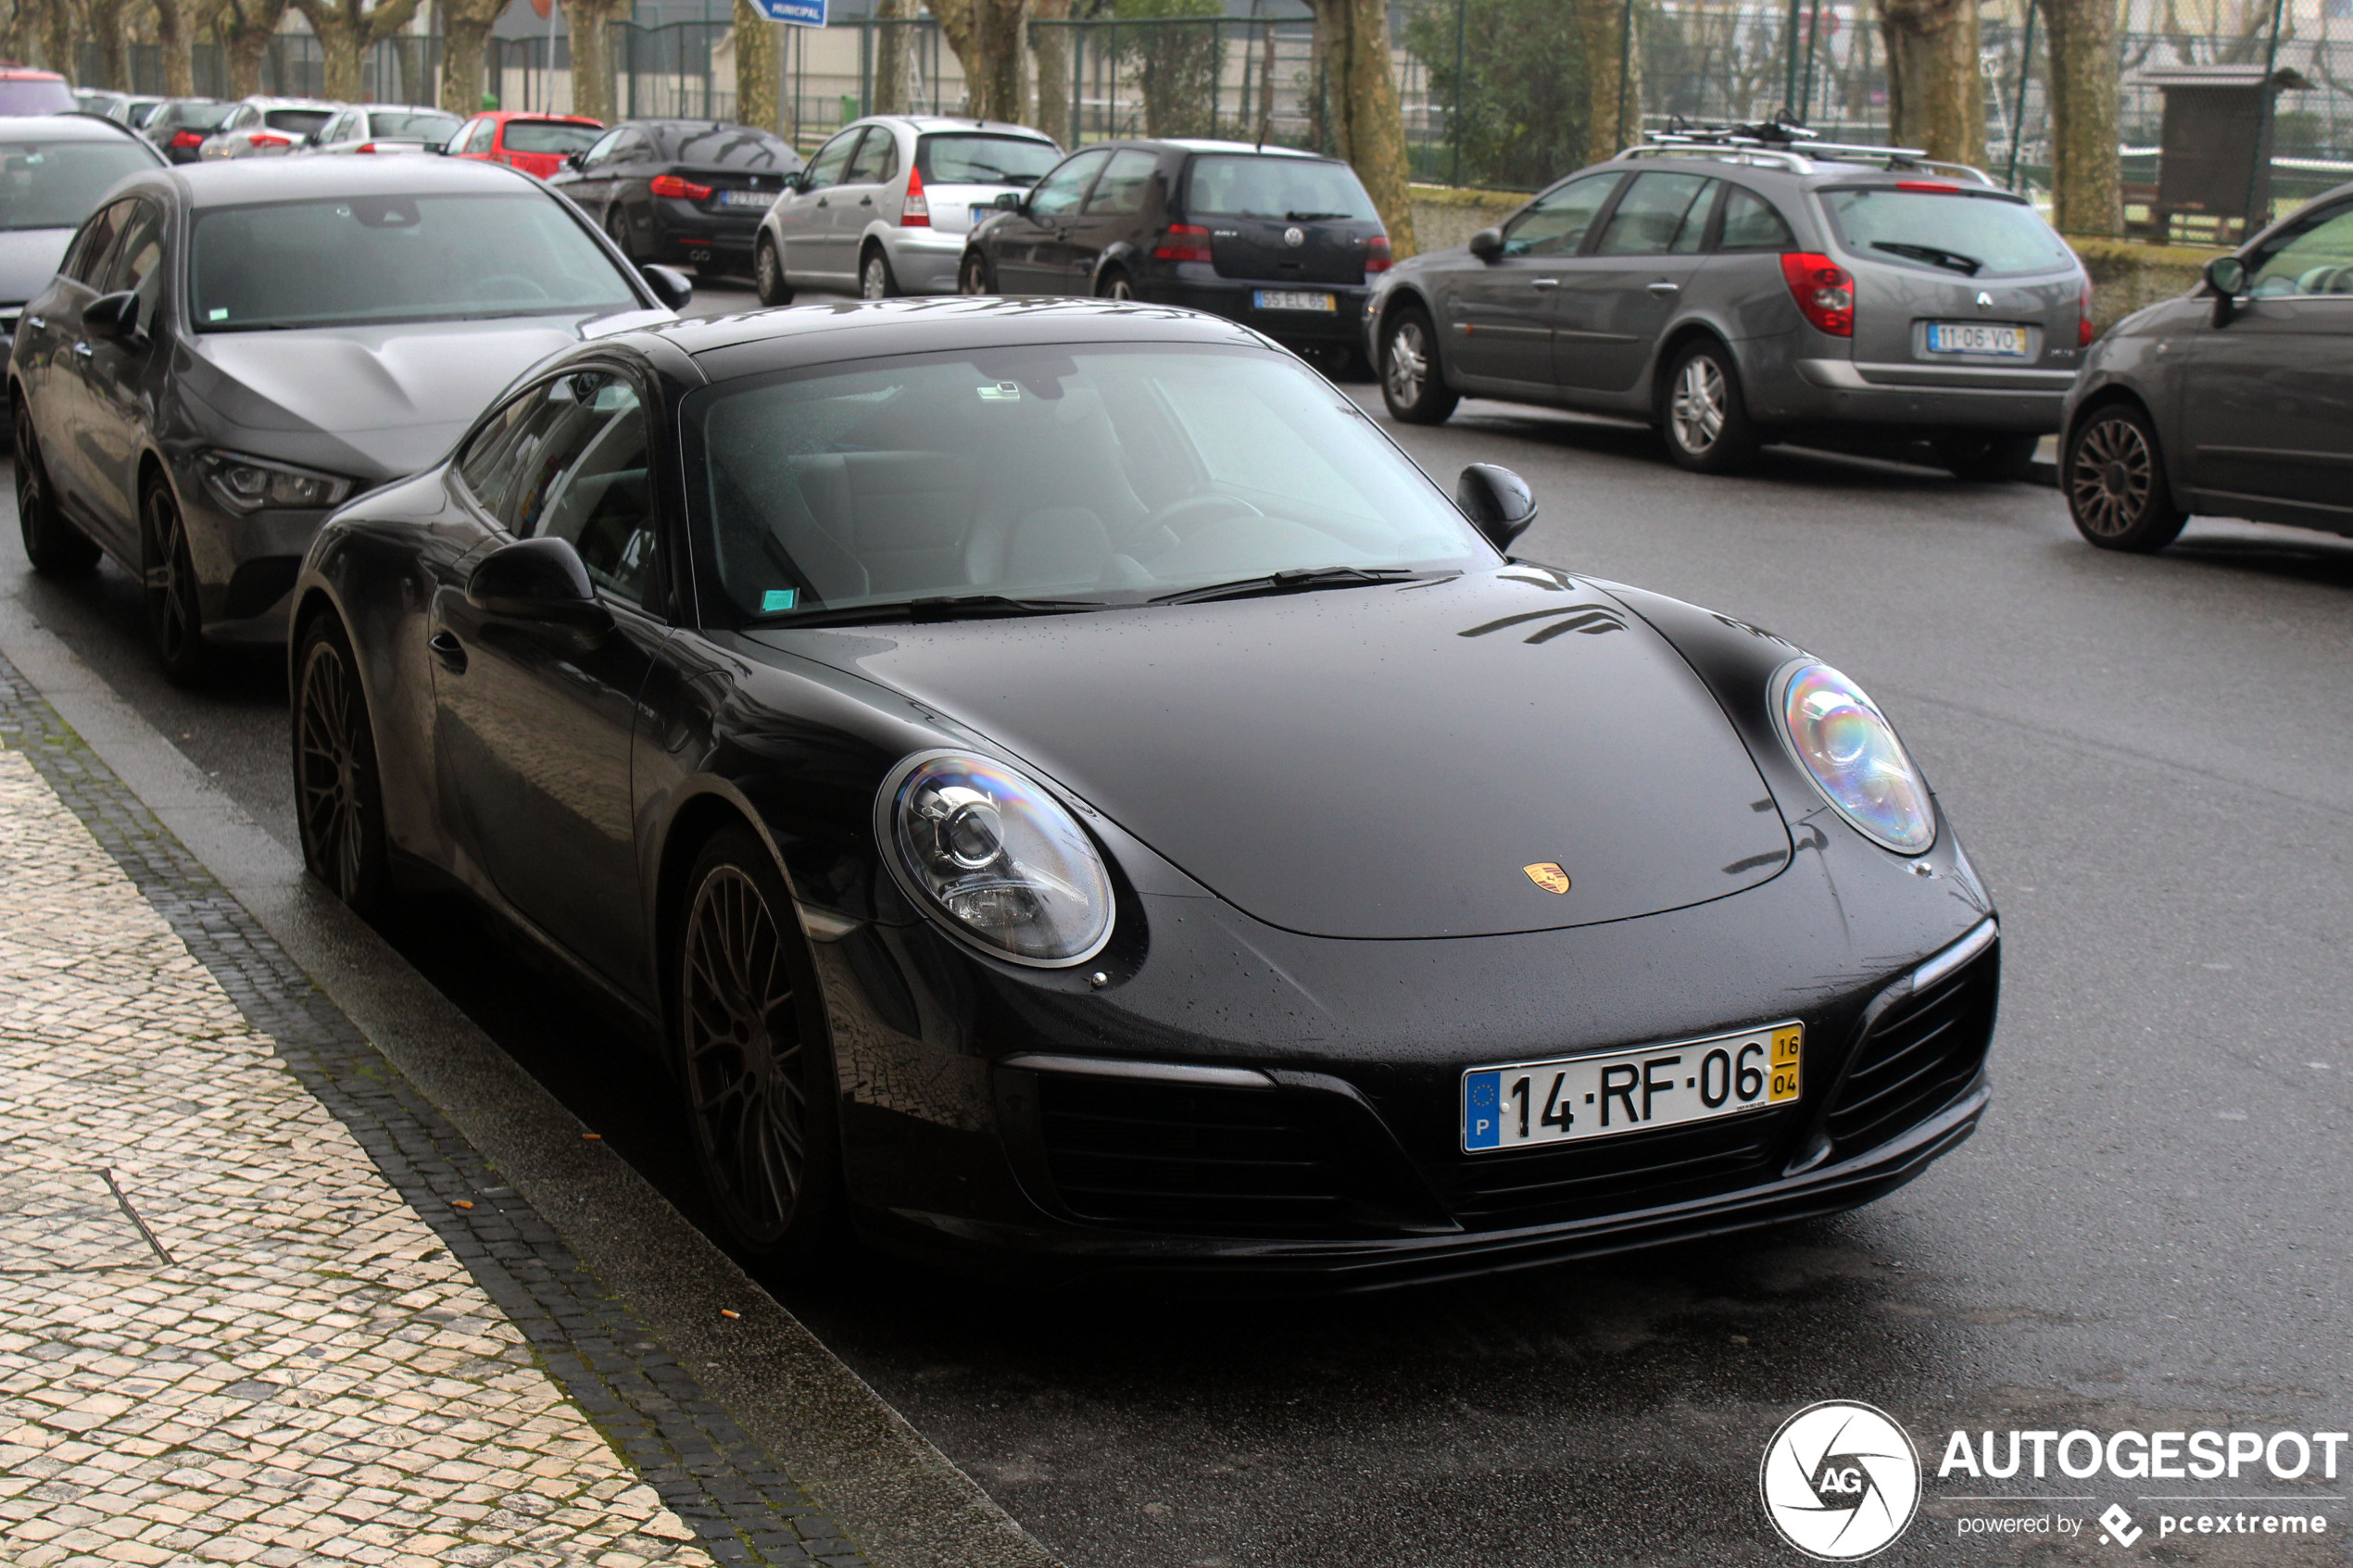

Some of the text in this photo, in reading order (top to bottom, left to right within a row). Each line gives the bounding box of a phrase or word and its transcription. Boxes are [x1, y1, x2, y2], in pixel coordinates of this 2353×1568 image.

[772, 3, 821, 19] MUNICIPAL
[1780, 1036, 1799, 1057] 16
[1774, 1073, 1796, 1094] 04
[1476, 1119, 1490, 1135] P
